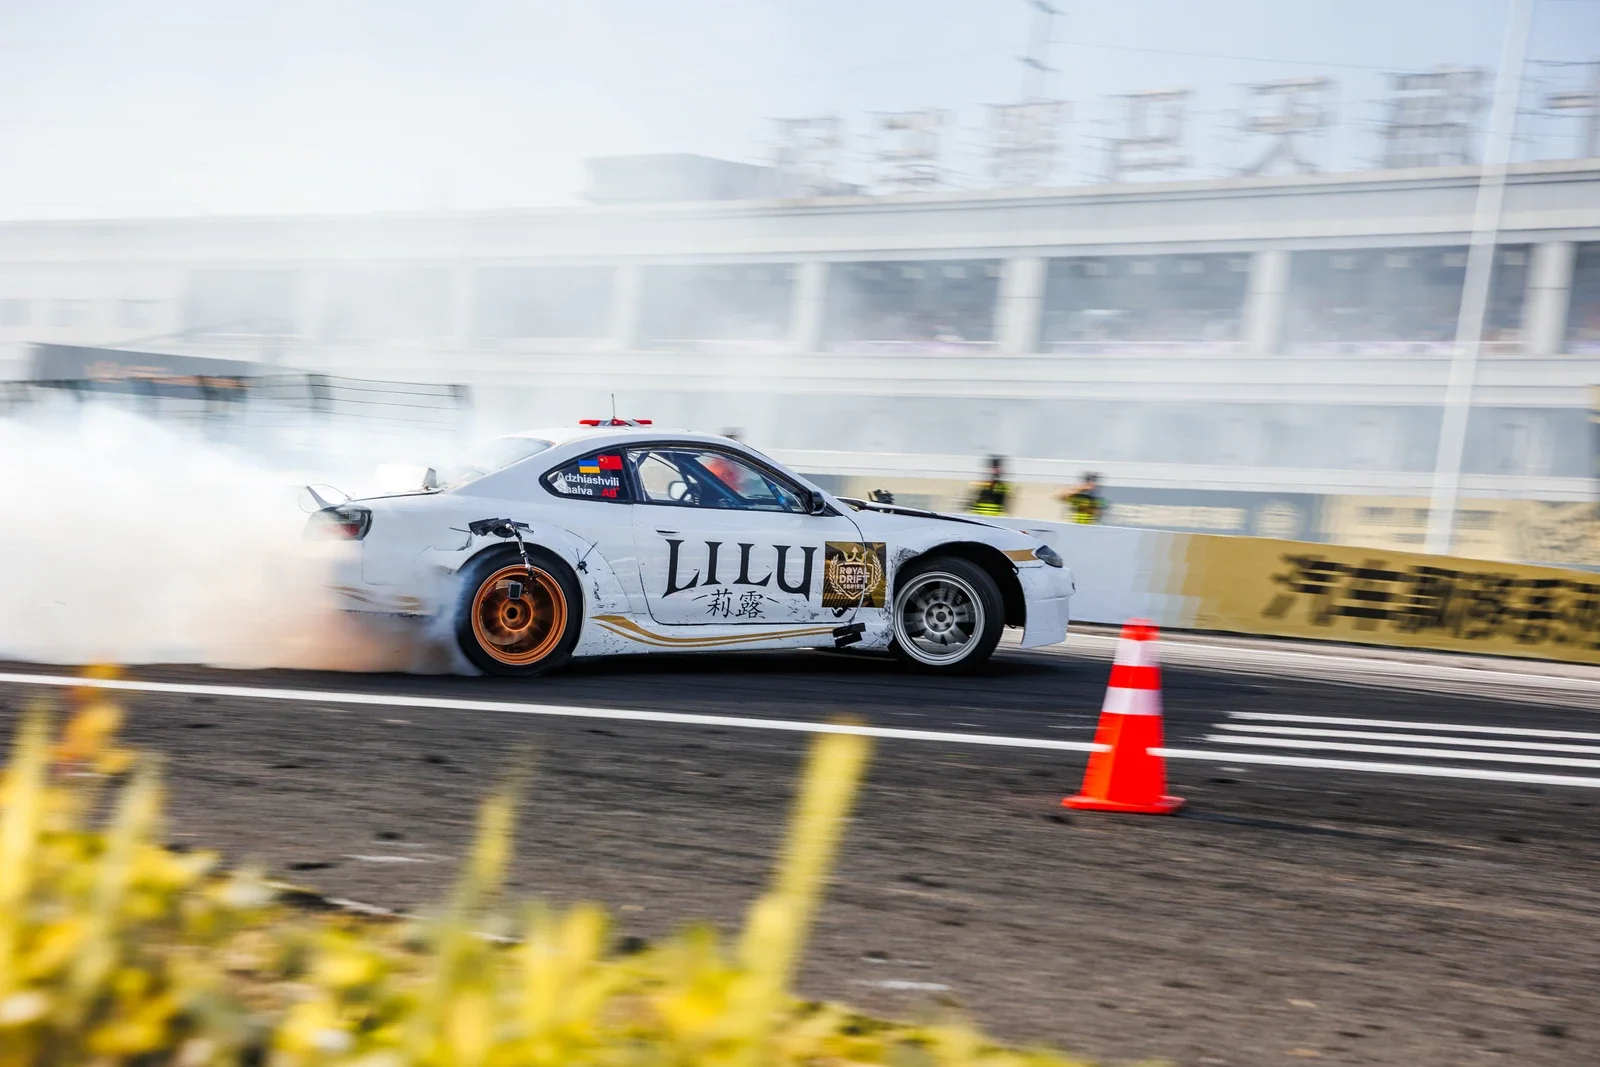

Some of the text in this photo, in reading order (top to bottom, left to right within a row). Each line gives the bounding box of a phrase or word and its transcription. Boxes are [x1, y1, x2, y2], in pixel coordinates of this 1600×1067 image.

[557, 472, 619, 487] Adzhiashvili
[661, 538, 819, 602] LILU
[839, 566, 870, 575] ROYAL
[839, 574, 870, 584] DRIFT
[706, 588, 766, 620] 莉露
